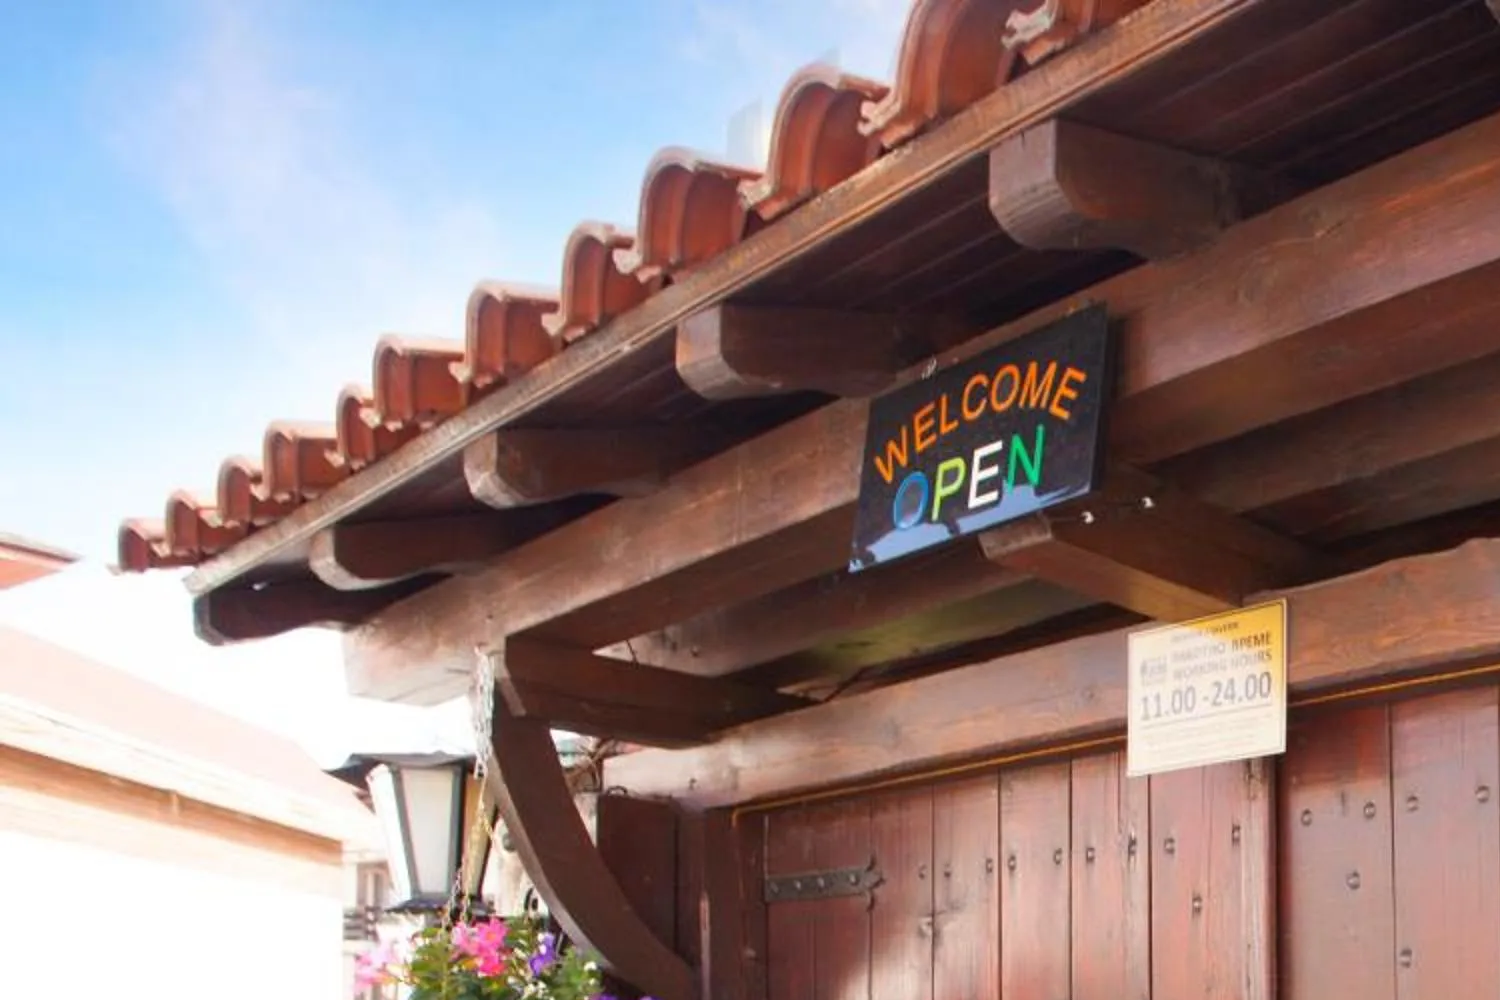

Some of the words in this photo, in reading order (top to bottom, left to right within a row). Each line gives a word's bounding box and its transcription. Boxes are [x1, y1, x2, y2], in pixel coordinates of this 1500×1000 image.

[874, 361, 1086, 484] WELCOME
[893, 424, 1045, 528] OPEN
[1141, 685, 1196, 721] 11.00
